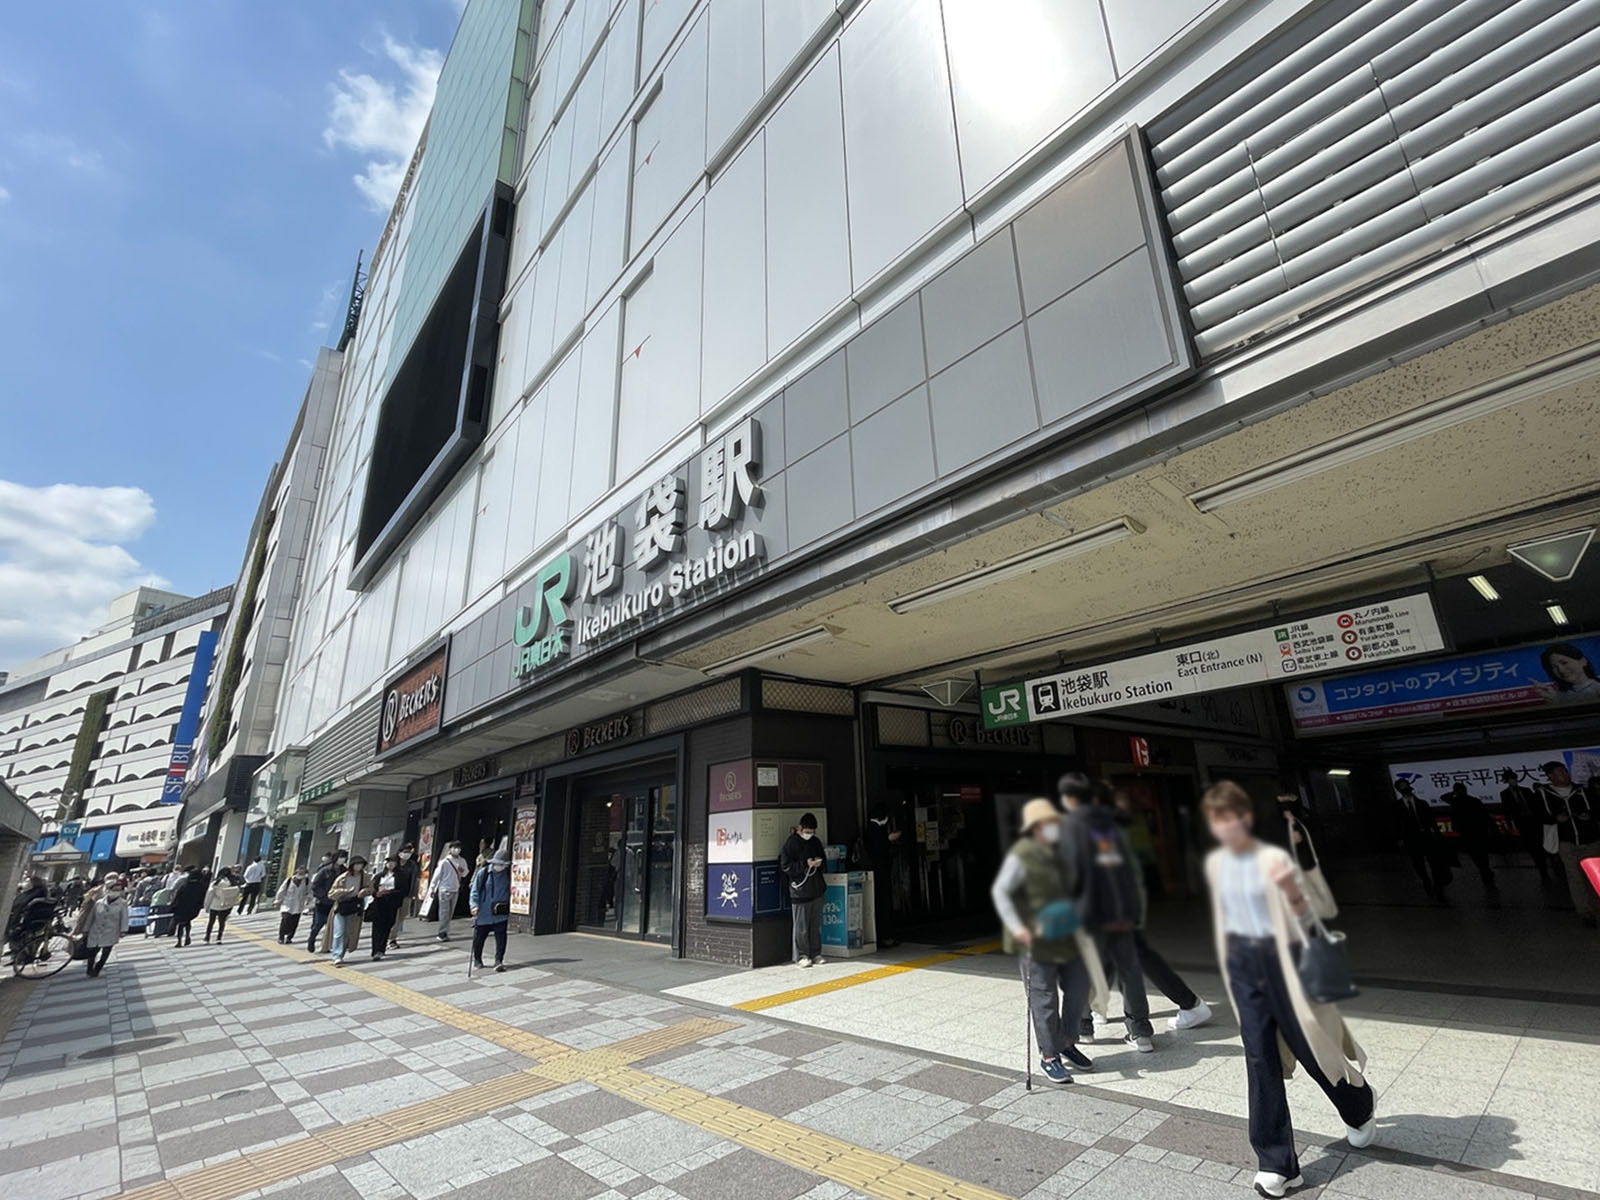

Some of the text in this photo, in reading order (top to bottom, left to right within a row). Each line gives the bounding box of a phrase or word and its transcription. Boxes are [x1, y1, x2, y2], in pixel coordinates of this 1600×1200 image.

[581, 418, 763, 602] 池袋駅
[512, 553, 574, 647] JR
[577, 530, 757, 644] Ikebukuro Station
[1290, 623, 1308, 634] JR線
[512, 630, 567, 679] JR東日本
[1176, 649, 1220, 667] 東口(北)
[1177, 652, 1263, 678] East Entrance (N)
[399, 674, 439, 721] BECKER'S
[1061, 670, 1110, 696] 池袋駅
[1062, 680, 1173, 710] Ikebukuro Station
[1335, 662, 1520, 701] コンタクトのアイシティ
[988, 688, 1021, 715] JR
[583, 715, 631, 748] BECKER'S
[165, 744, 192, 794] SEIBU
